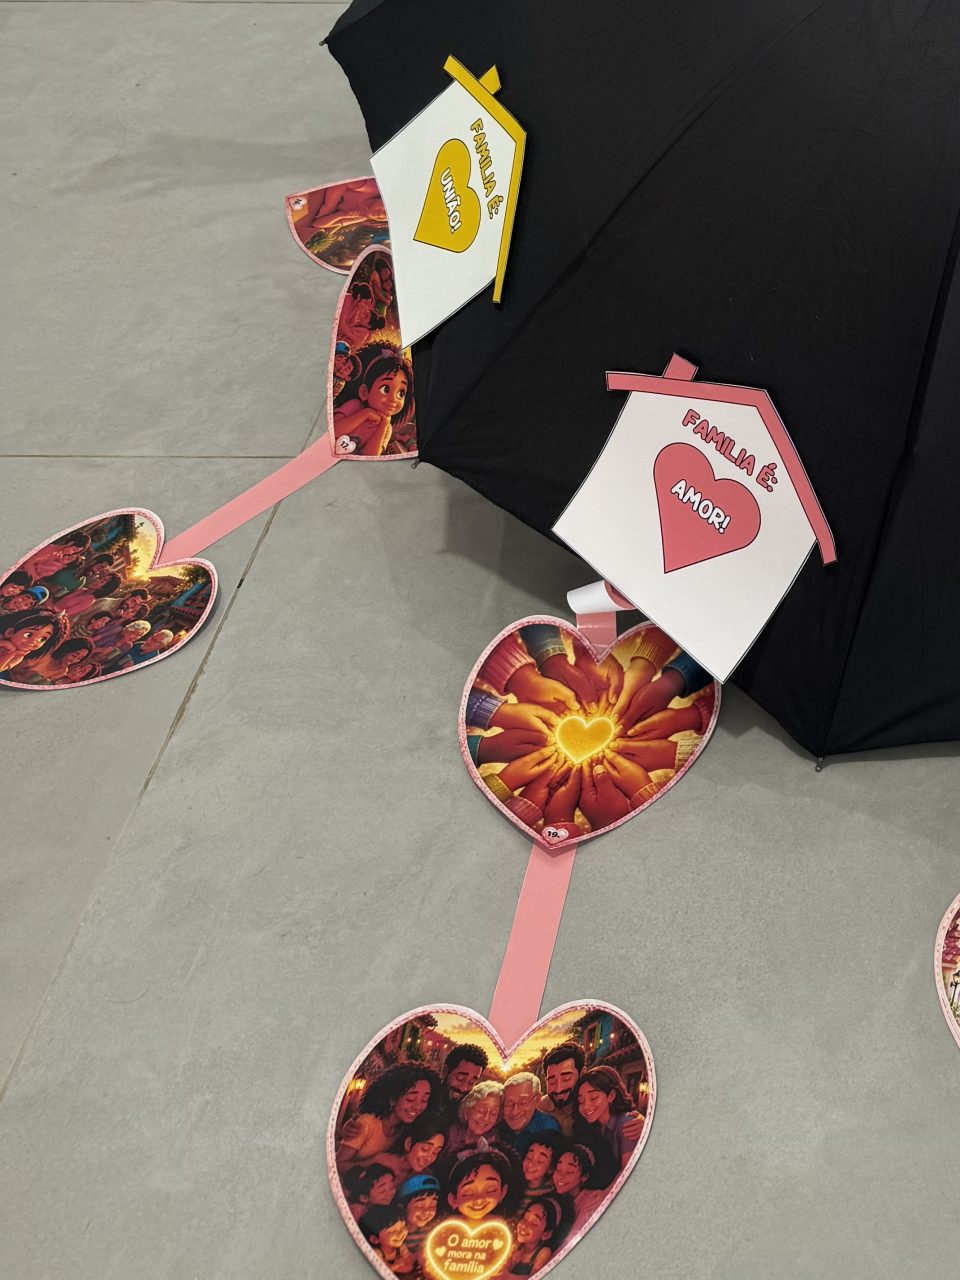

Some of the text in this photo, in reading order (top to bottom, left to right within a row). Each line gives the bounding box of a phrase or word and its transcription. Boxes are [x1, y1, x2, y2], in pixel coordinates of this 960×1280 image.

[470, 118, 497, 198] FAMILIA
[440, 167, 463, 234] UNIÃO!
[682, 408, 757, 476] FAMILIA
[671, 479, 732, 534] AMOR!
[547, 830, 560, 838] 19.
[447, 1233, 492, 1249] O amor
[447, 1250, 486, 1260] mora na
[443, 1258, 485, 1273] família
